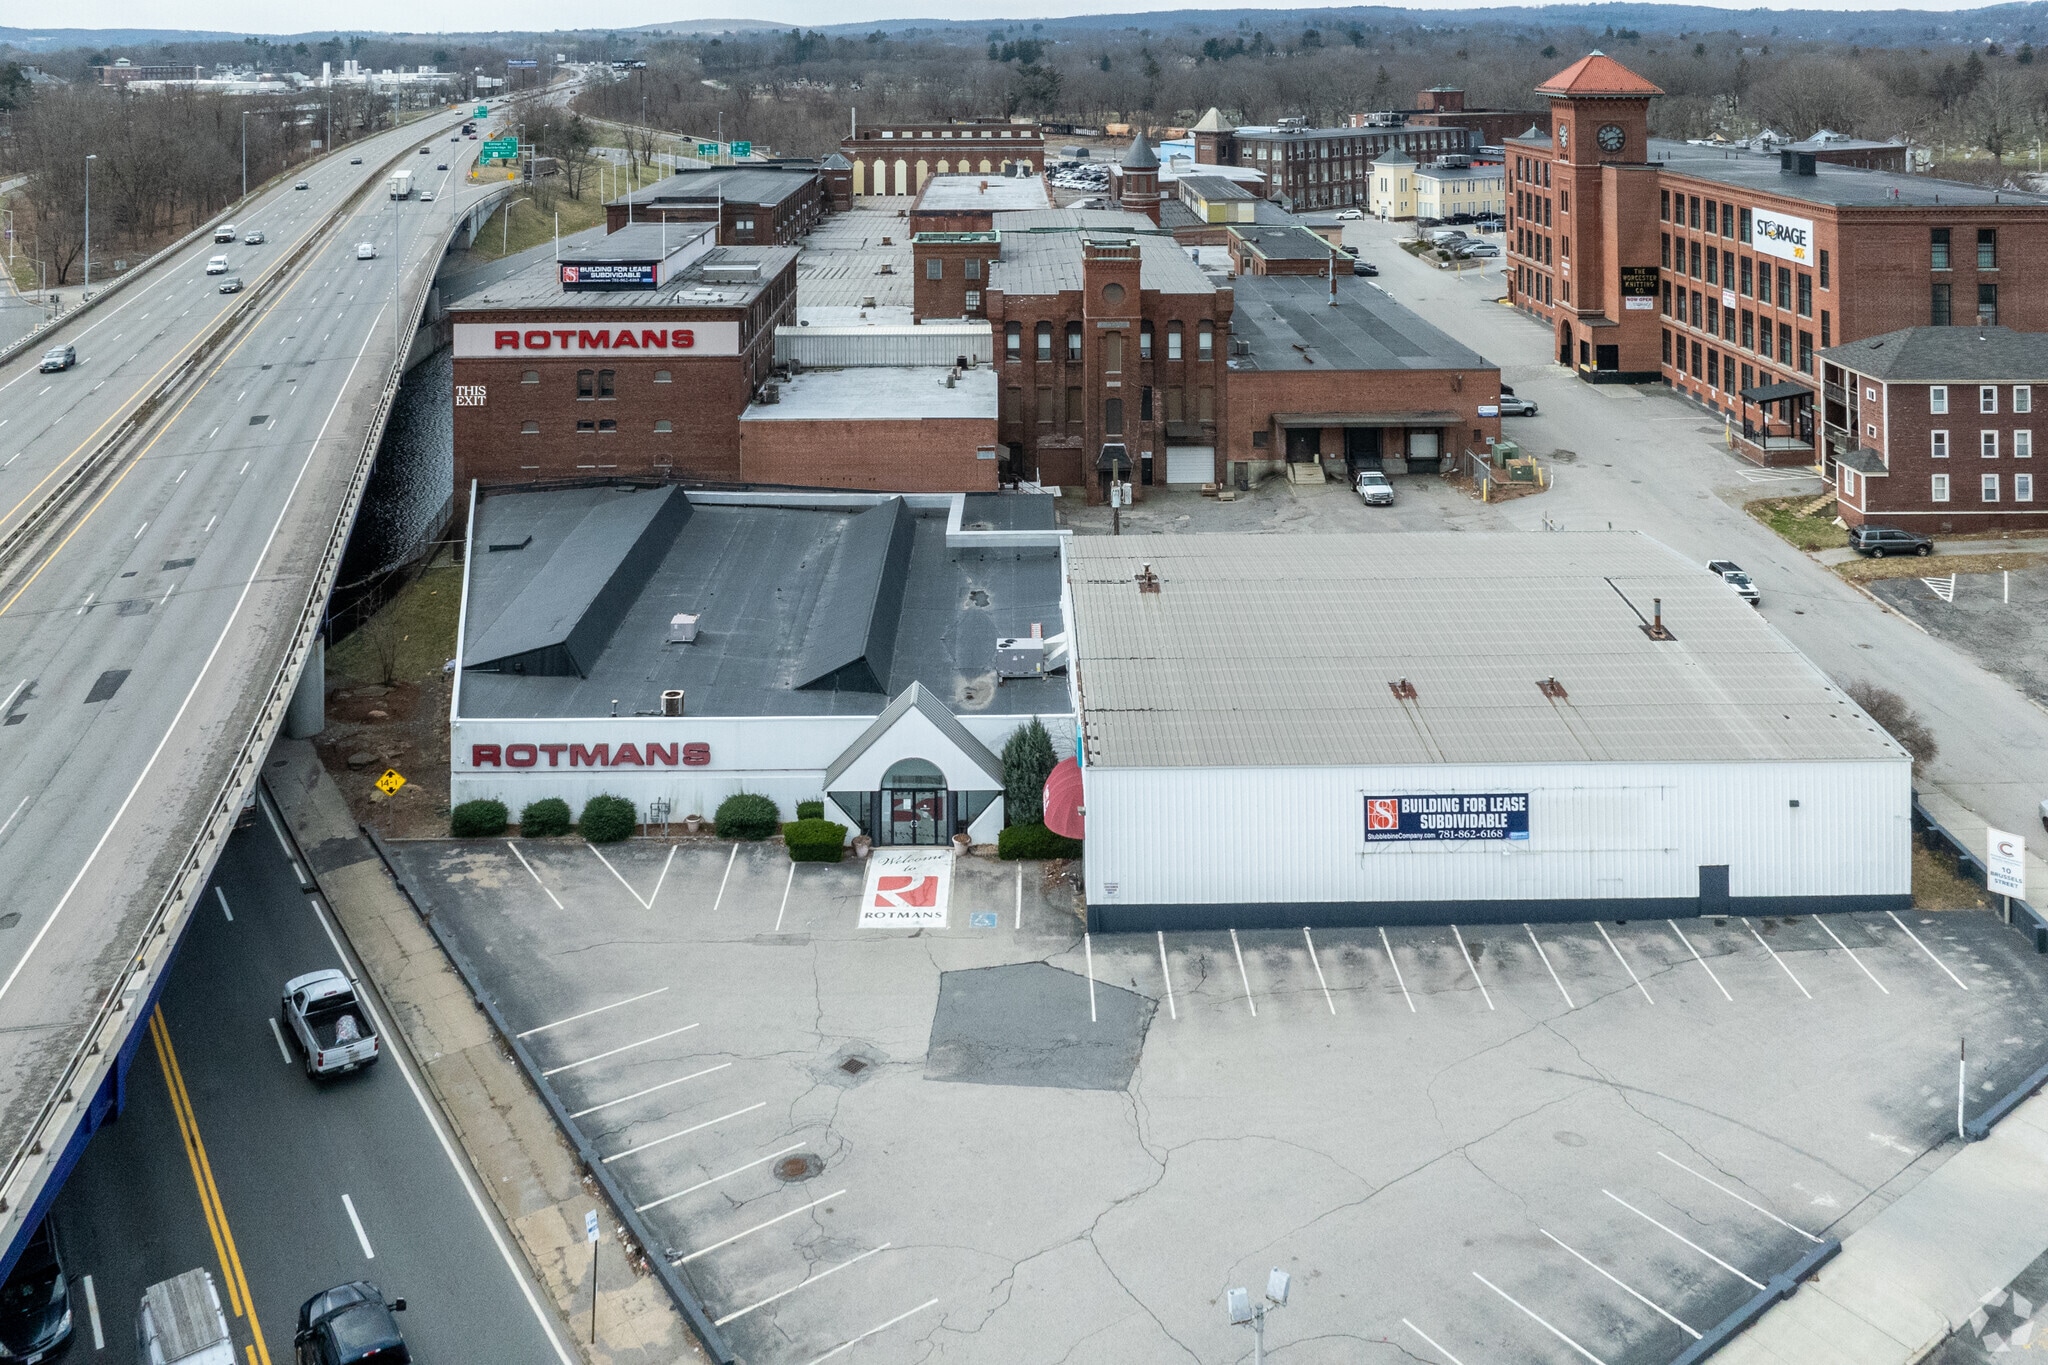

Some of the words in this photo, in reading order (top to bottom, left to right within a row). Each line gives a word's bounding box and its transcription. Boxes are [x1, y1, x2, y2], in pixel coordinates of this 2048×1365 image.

[1757, 218, 1807, 247] STORAGE
[494, 329, 695, 350] ROTMANS
[455, 385, 487, 396] THIS
[455, 395, 487, 406] EXIT
[472, 742, 712, 768] ROTMANS
[1401, 798, 1460, 813] BUILDING
[1463, 797, 1488, 812] FOR
[1490, 796, 1526, 812] LEASE
[1420, 813, 1508, 829] SUBDIVIDABLE
[1438, 829, 1504, 839] 781-862-6168
[877, 854, 943, 866] Welcome
[1990, 870, 2023, 884] BRUSSELS
[2001, 866, 2012, 875] 10
[1994, 878, 2019, 889] STREET
